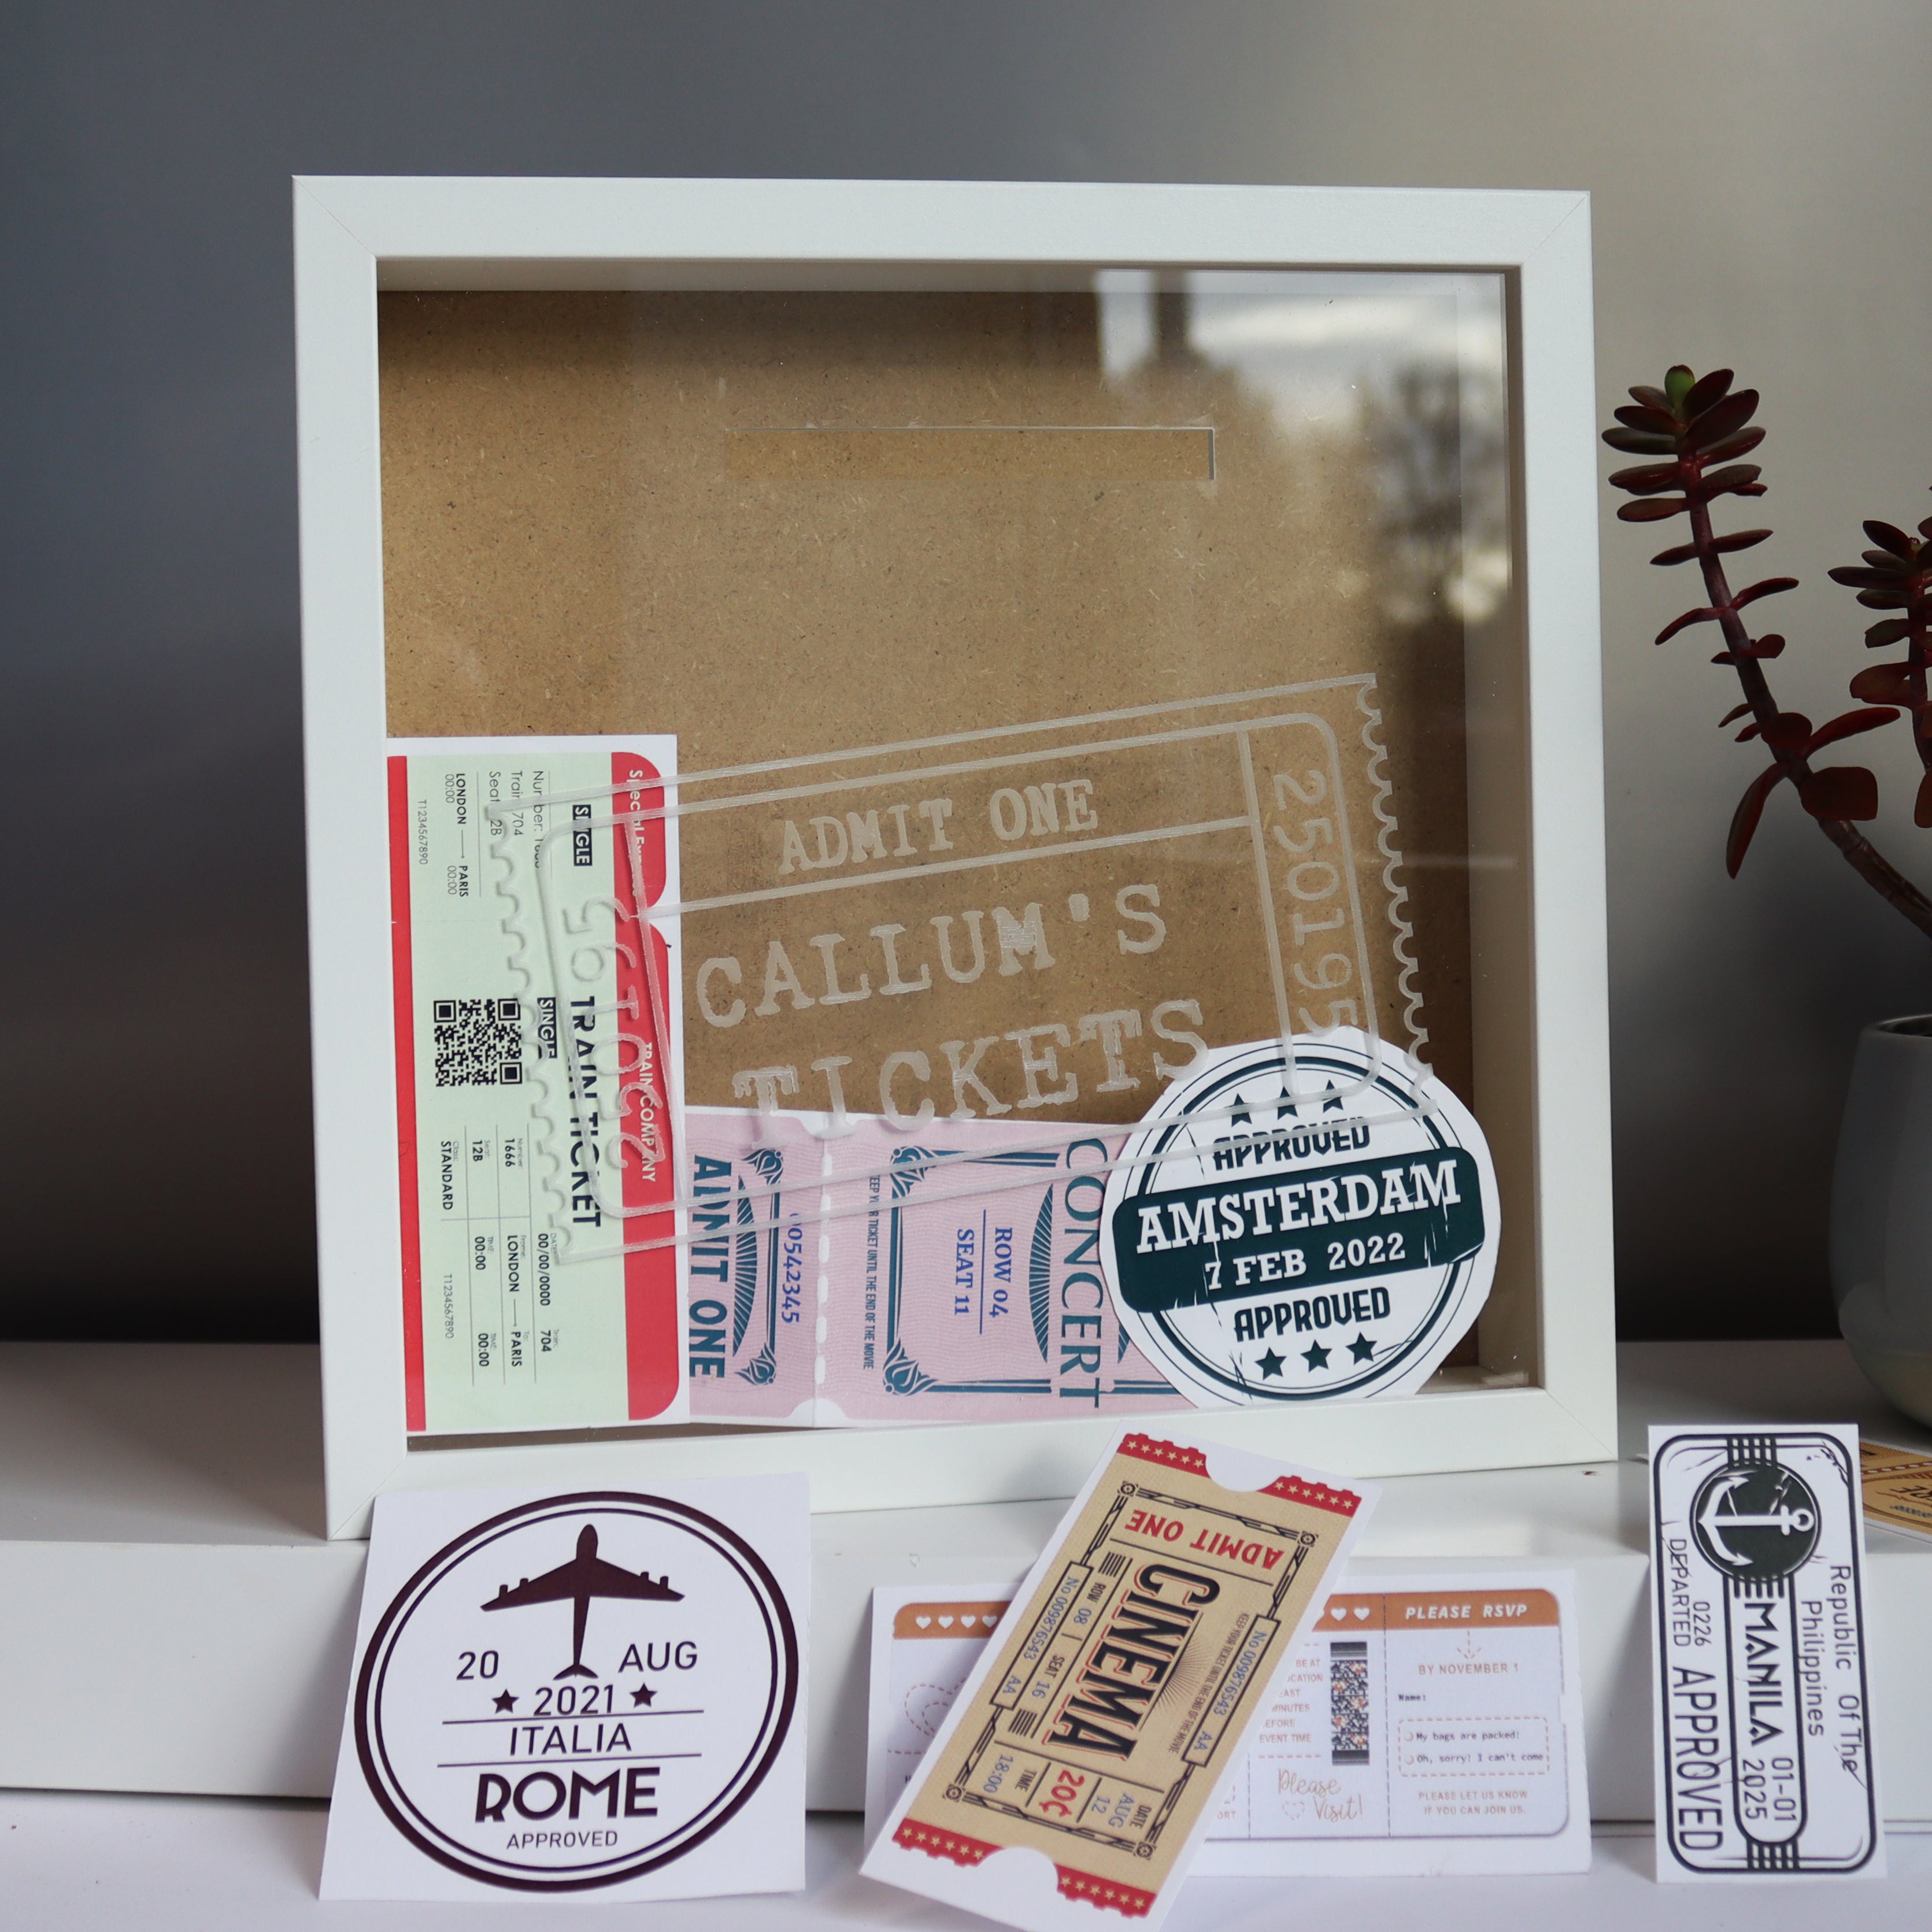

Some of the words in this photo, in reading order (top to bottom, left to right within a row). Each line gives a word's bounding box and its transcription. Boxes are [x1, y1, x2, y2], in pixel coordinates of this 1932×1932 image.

[445, 773, 456, 804] 00:00
[456, 772, 467, 825] LONDON
[417, 799, 428, 865] T1234567890
[512, 812, 524, 837] 704
[778, 798, 953, 875] ADMIT
[989, 779, 1098, 841] ONE
[447, 865, 457, 895] 00:00
[458, 865, 469, 898] PARIS
[1272, 769, 1359, 1037] 250195
[697, 883, 1167, 1028] CALLUM'S
[732, 998, 1210, 1149] TICKETS
[472, 1139, 483, 1162] 12B
[504, 1138, 516, 1167] 1666
[441, 1141, 454, 1211] STANDARD
[1136, 1159, 1461, 1254] AMSTERDAM
[867, 1219, 879, 1248] TICKET
[474, 1236, 486, 1271] 00:00
[507, 1234, 520, 1293] LONDON
[536, 1233, 551, 1306] 00/00/0000
[866, 1249, 878, 1274] UNTIL
[955, 1228, 975, 1289] SEAT
[993, 1227, 1013, 1283] ROW
[1205, 1261, 1222, 1290] 7
[1233, 1249, 1306, 1286] FEB
[1327, 1233, 1406, 1271] 2022
[865, 1275, 877, 1292] THE
[1059, 1138, 1109, 1409] CONCERT
[443, 1273, 454, 1339] T1234567890
[864, 1312, 875, 1323] OF
[865, 1293, 876, 1311] END
[954, 1295, 970, 1316] 11
[989, 1289, 1009, 1318] 04
[1234, 1286, 1391, 1342] APPROVED
[510, 1331, 523, 1367] PARIS
[540, 1330, 552, 1353] 704
[688, 1298, 728, 1379] ONE
[864, 1325, 875, 1341] THE
[478, 1333, 490, 1367] 00:00
[863, 1343, 875, 1370] MOVIE
[1124, 1509, 1184, 1542] ONE
[1189, 1528, 1285, 1570] ADMIT
[1086, 1582, 1107, 1603] ROW
[1670, 1538, 1692, 1647] DEPARTED
[1023, 1596, 1069, 1660] 009876543
[1073, 1607, 1092, 1625] 08
[1405, 1605, 1472, 1619] PLEASE
[1483, 1604, 1528, 1618] RSVP
[1693, 1601, 1712, 1647] 0226
[1826, 1565, 1857, 1670] Republic
[456, 1649, 499, 1681] 20
[617, 1640, 698, 1674] AUG
[1041, 1564, 1220, 1762] CINEMA
[1044, 1655, 1065, 1678] SEAT
[1309, 1659, 1321, 1667] AT
[1418, 1664, 1435, 1675] BY
[1439, 1663, 1508, 1675] NOVEMBER
[1513, 1663, 1519, 1672] 1
[1744, 1602, 1785, 1747] MANILA
[1800, 1600, 1828, 1736] Philippines
[1002, 1675, 1022, 1694] AA
[1031, 1681, 1051, 1698] 16
[1213, 1650, 1257, 1716] 009876543
[1398, 1694, 1427, 1702] Name:
[533, 1684, 614, 1716] 2021
[1838, 1694, 1861, 1720] Of
[509, 1722, 632, 1756] ITALIA
[1193, 1730, 1213, 1750] AA
[1259, 1734, 1288, 1744] EVENT
[1290, 1734, 1312, 1742] TIME
[1416, 1732, 1428, 1742] My
[1432, 1732, 1456, 1742] bags
[1482, 1731, 1520, 1741] packed!
[1840, 1727, 1863, 1772] The
[982, 1753, 1014, 1793] 18:00
[1416, 1755, 1433, 1764] Oh,
[1439, 1754, 1471, 1764] sorry!
[1489, 1753, 1516, 1761] can't
[1672, 1666, 1723, 1850] APPROVED
[474, 1766, 661, 1823] ROME
[1015, 1768, 1038, 1793] TIME
[1278, 1768, 1342, 1798] Please
[1418, 1792, 1457, 1801] PLEASE
[1460, 1792, 1478, 1800] LET
[1498, 1790, 1528, 1799] KNOW
[1742, 1758, 1768, 1820] 2025
[1771, 1757, 1798, 1822] 01-01
[1091, 1796, 1111, 1814] 12
[1107, 1792, 1135, 1829] AUG
[1129, 1804, 1152, 1830] DATE
[1312, 1793, 1364, 1823] Visit!
[1424, 1807, 1433, 1815] IF
[1436, 1806, 1457, 1815] YOU
[1460, 1806, 1481, 1814] CAN
[1484, 1805, 1507, 1814] JOIN
[505, 1830, 619, 1850] APPROVED
